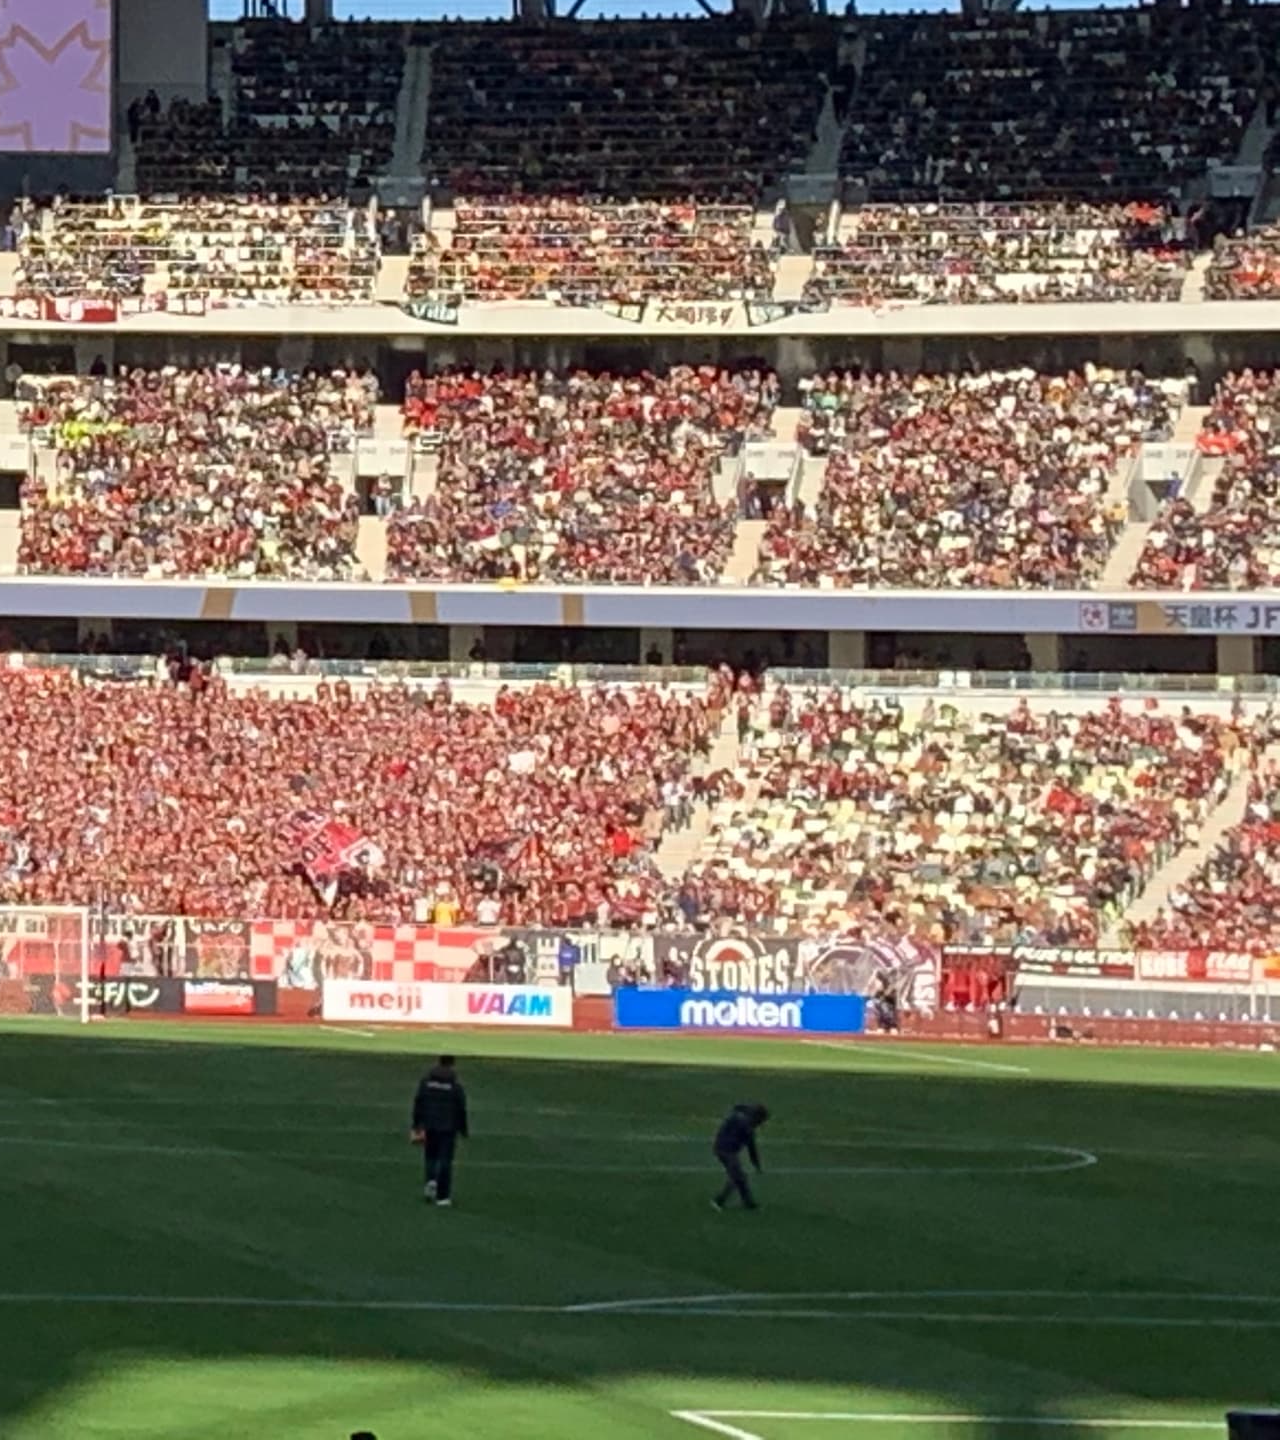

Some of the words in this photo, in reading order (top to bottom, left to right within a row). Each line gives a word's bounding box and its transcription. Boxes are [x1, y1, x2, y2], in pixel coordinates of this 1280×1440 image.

[1164, 604, 1238, 629] 天皇杯
[690, 948, 791, 994] STONES
[348, 986, 423, 1015] meiji
[466, 991, 553, 1017] VAAM
[680, 997, 803, 1028] molten
